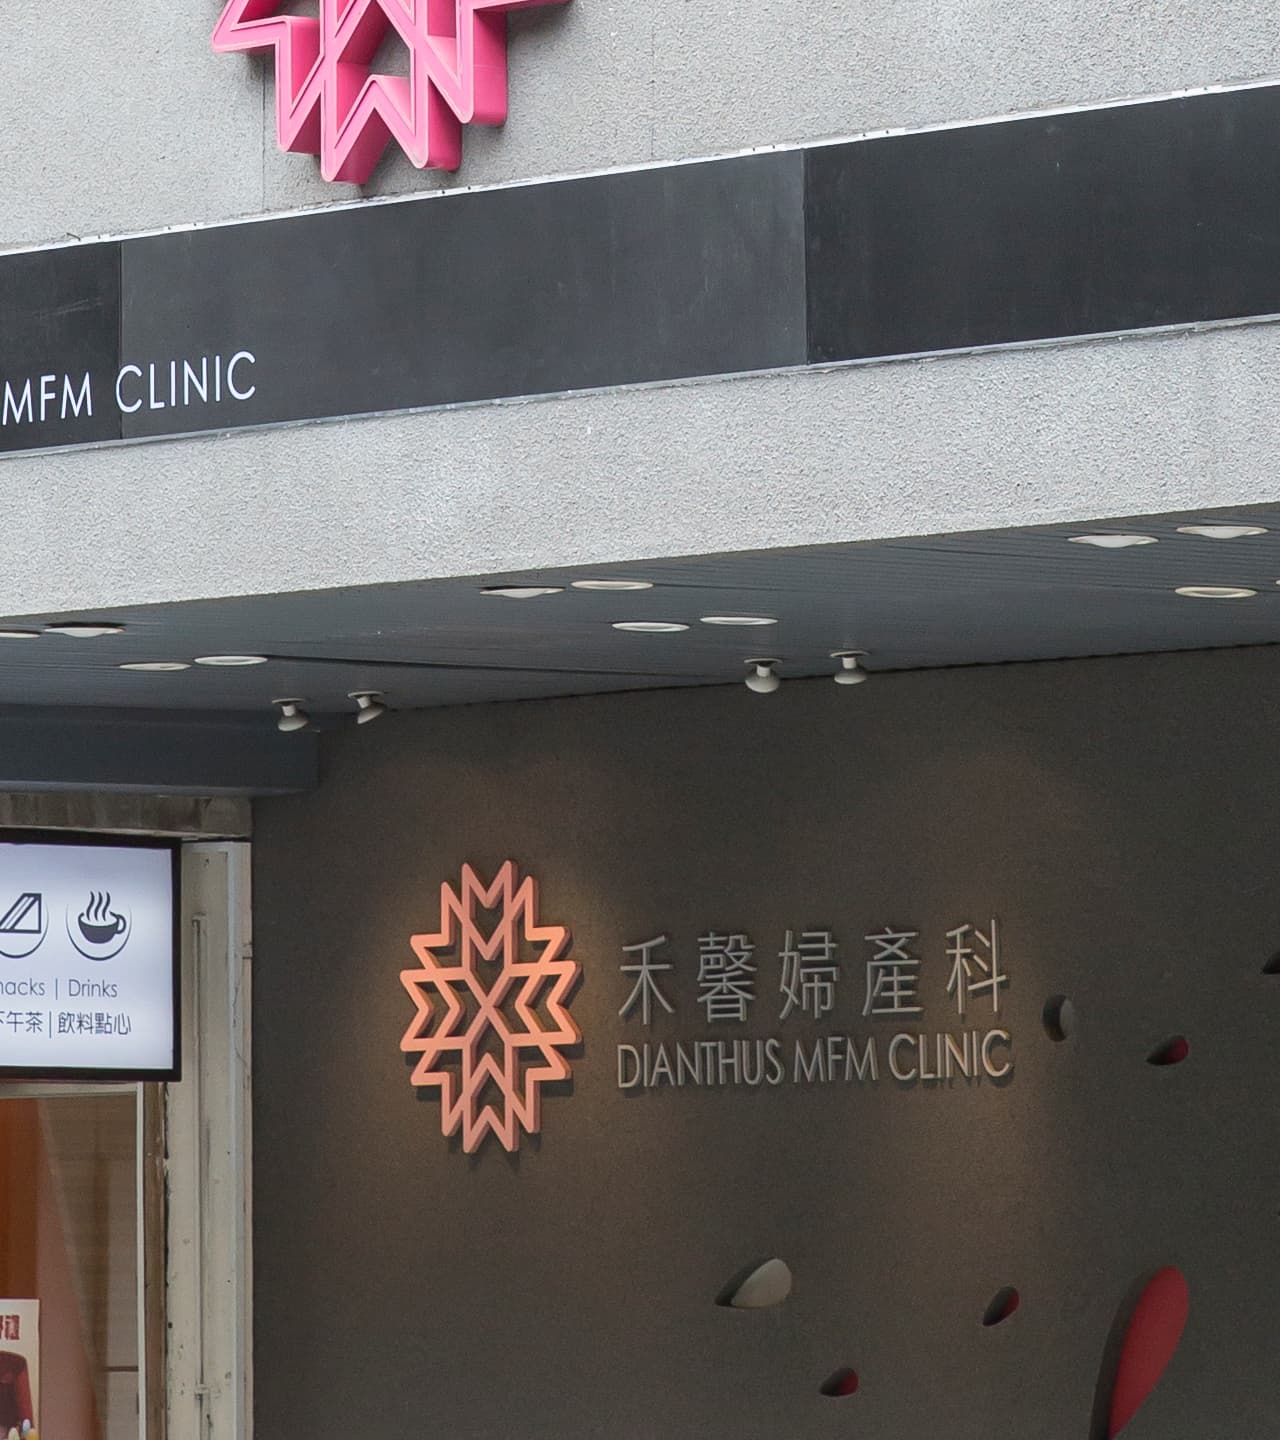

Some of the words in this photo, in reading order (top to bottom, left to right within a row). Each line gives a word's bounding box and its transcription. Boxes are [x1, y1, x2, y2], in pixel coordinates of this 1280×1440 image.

[2, 372, 93, 426] MFM
[116, 351, 256, 413] CLINIC
[68, 978, 118, 998] Drinks
[618, 918, 1008, 1026] 禾馨婦產科
[57, 1011, 132, 1035] 飲料點心
[617, 1038, 786, 1089] DIANTHUS
[792, 1035, 879, 1085] MFM
[888, 1029, 1015, 1082] CLINIC
